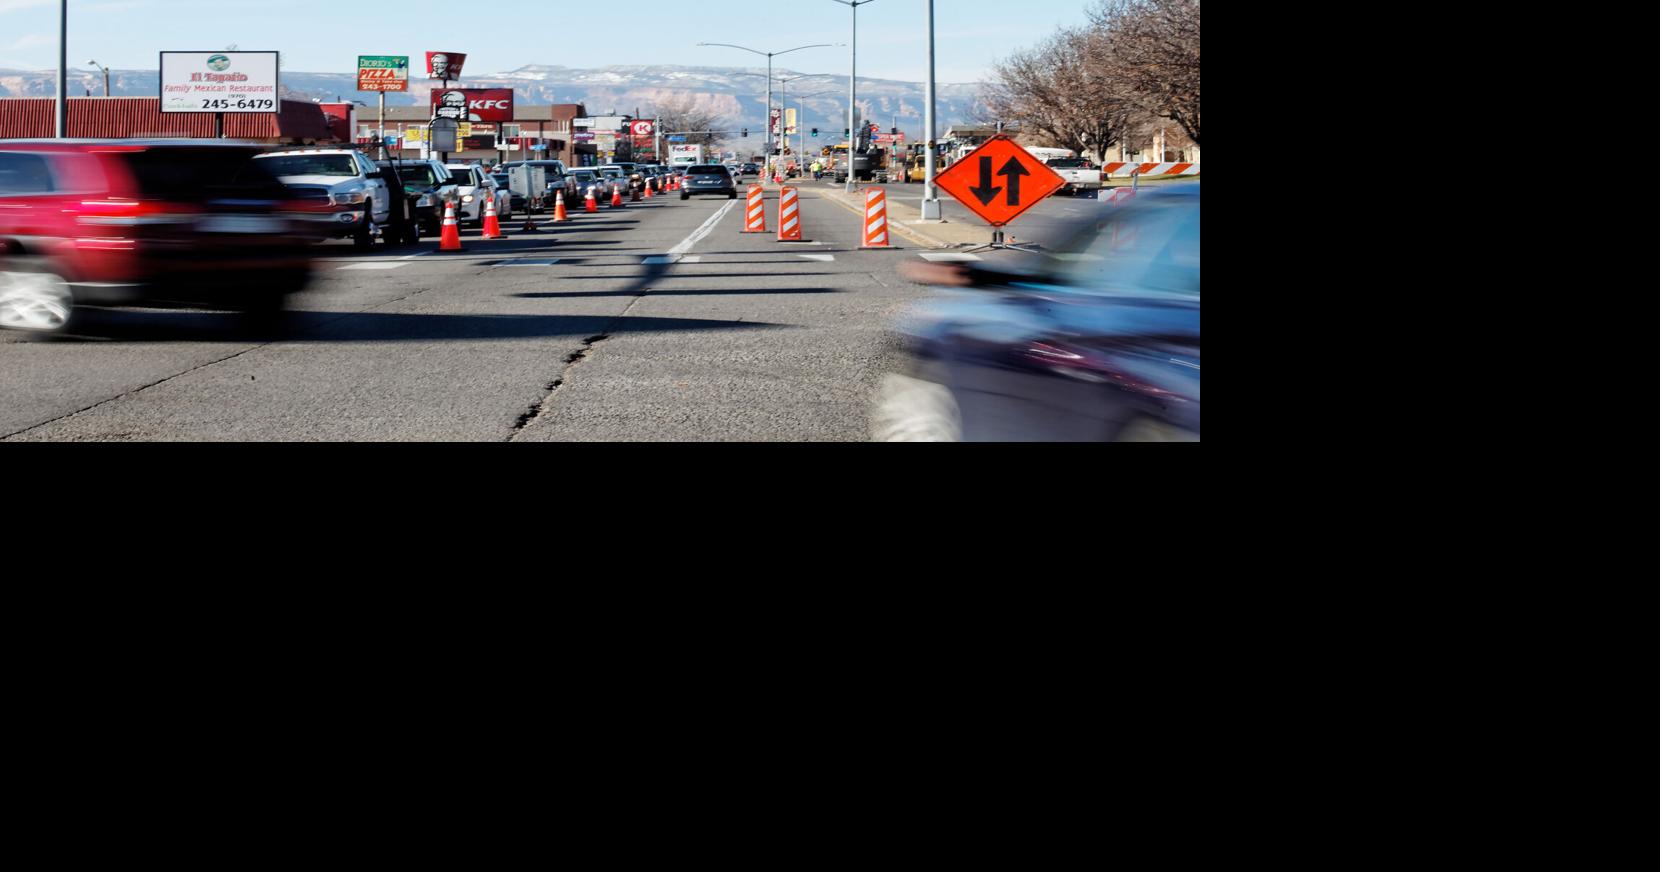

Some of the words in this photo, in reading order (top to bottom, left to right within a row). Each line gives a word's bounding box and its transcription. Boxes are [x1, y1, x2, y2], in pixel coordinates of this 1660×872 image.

[190, 72, 202, 82] El
[359, 69, 396, 79] PIZZA
[164, 85, 191, 94] Family
[202, 99, 273, 109] 245-6479
[469, 99, 509, 109] KFC
